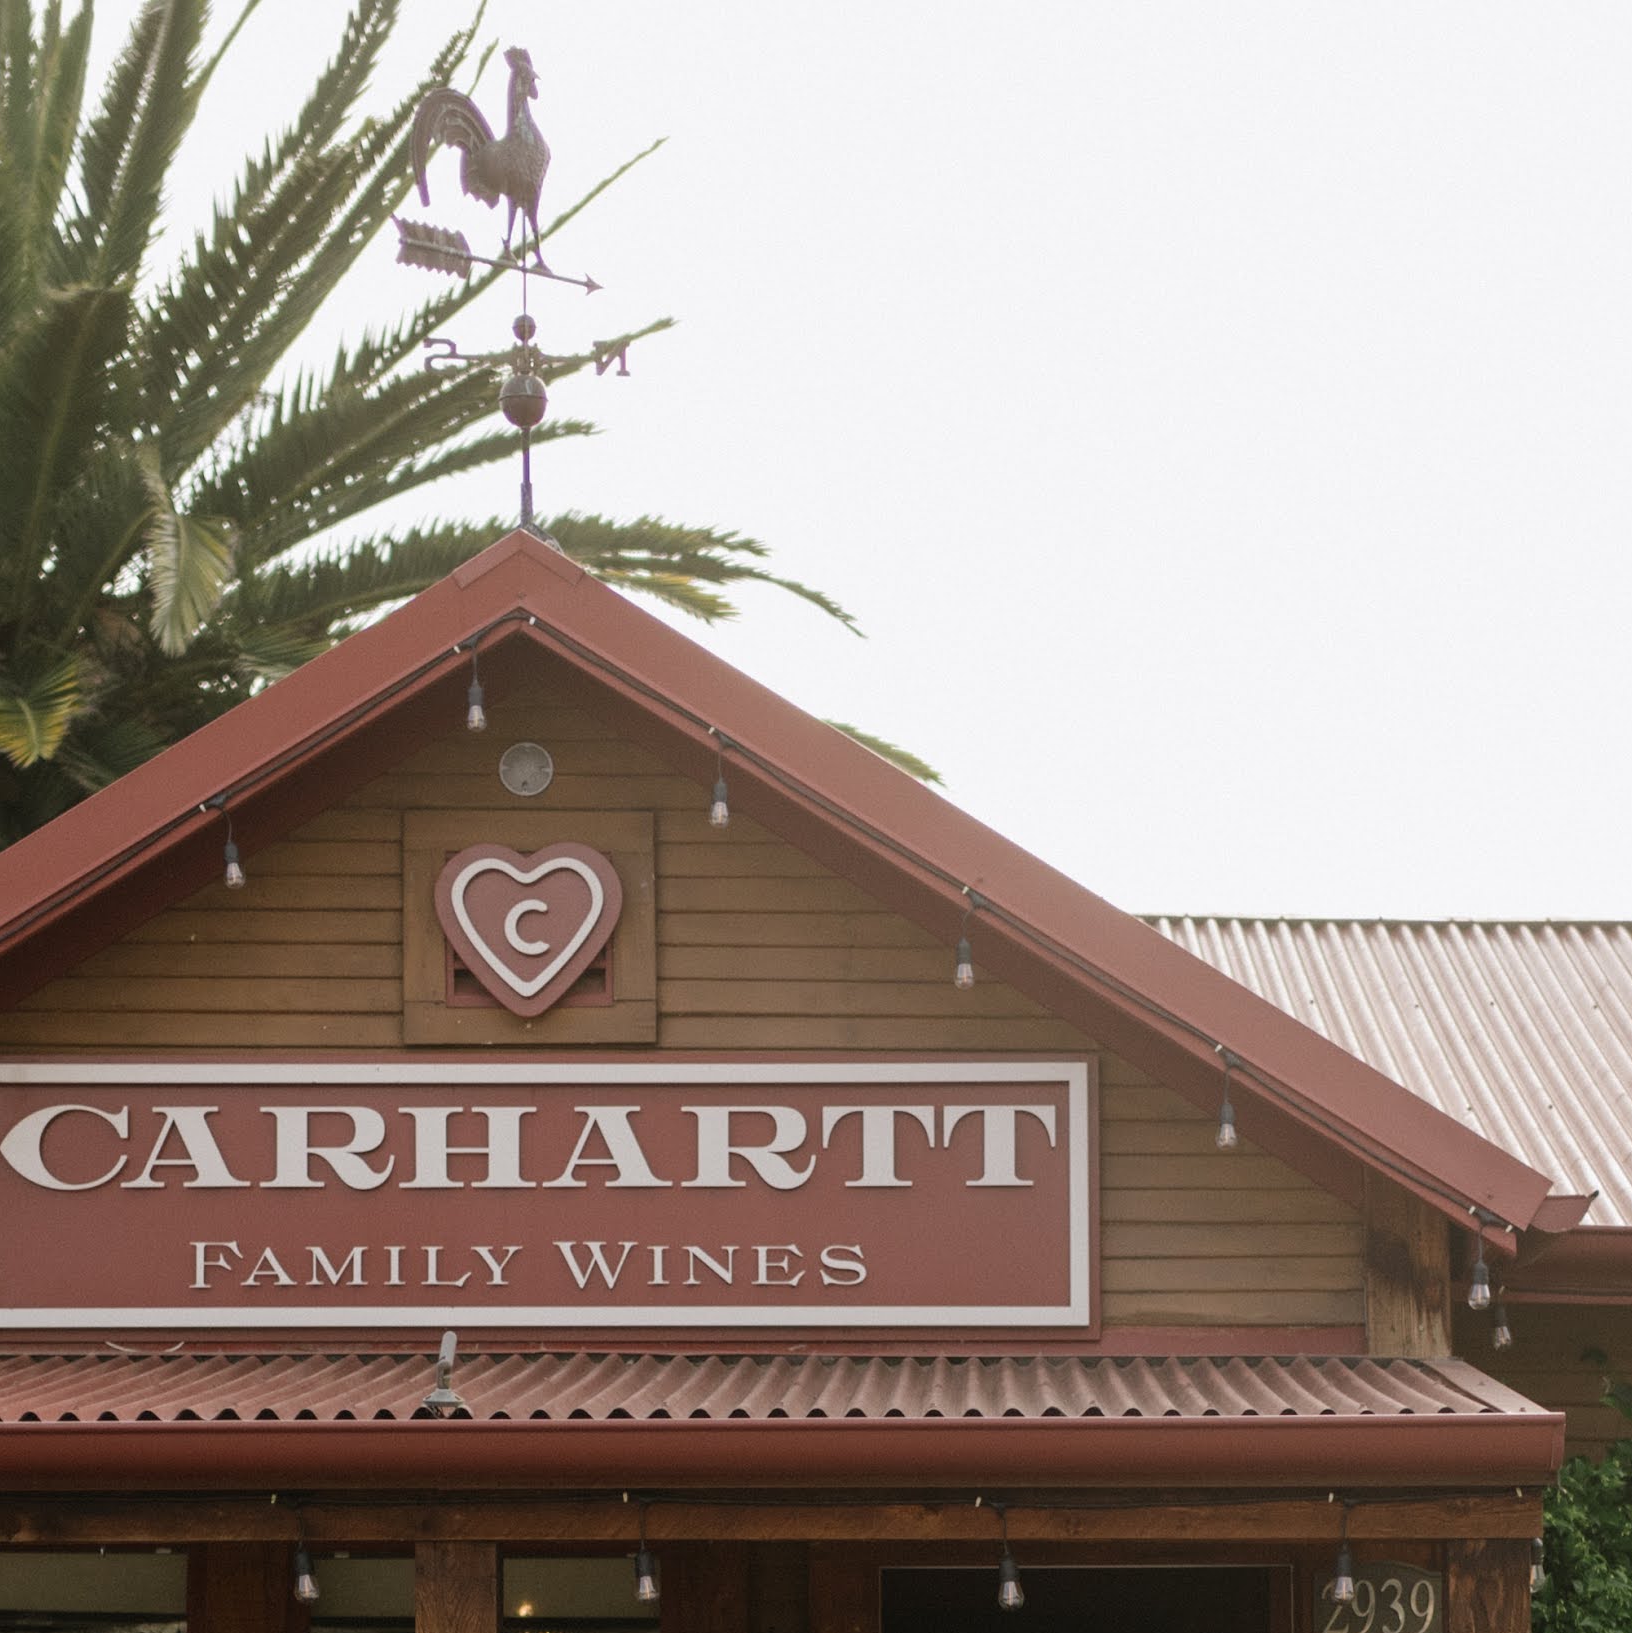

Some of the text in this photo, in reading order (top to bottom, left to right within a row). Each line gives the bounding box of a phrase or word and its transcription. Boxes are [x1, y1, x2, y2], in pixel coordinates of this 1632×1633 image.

[504, 899, 550, 955] C
[0, 1104, 1057, 1190] CARHARTT
[190, 1241, 867, 1289] FAMILY WINES
